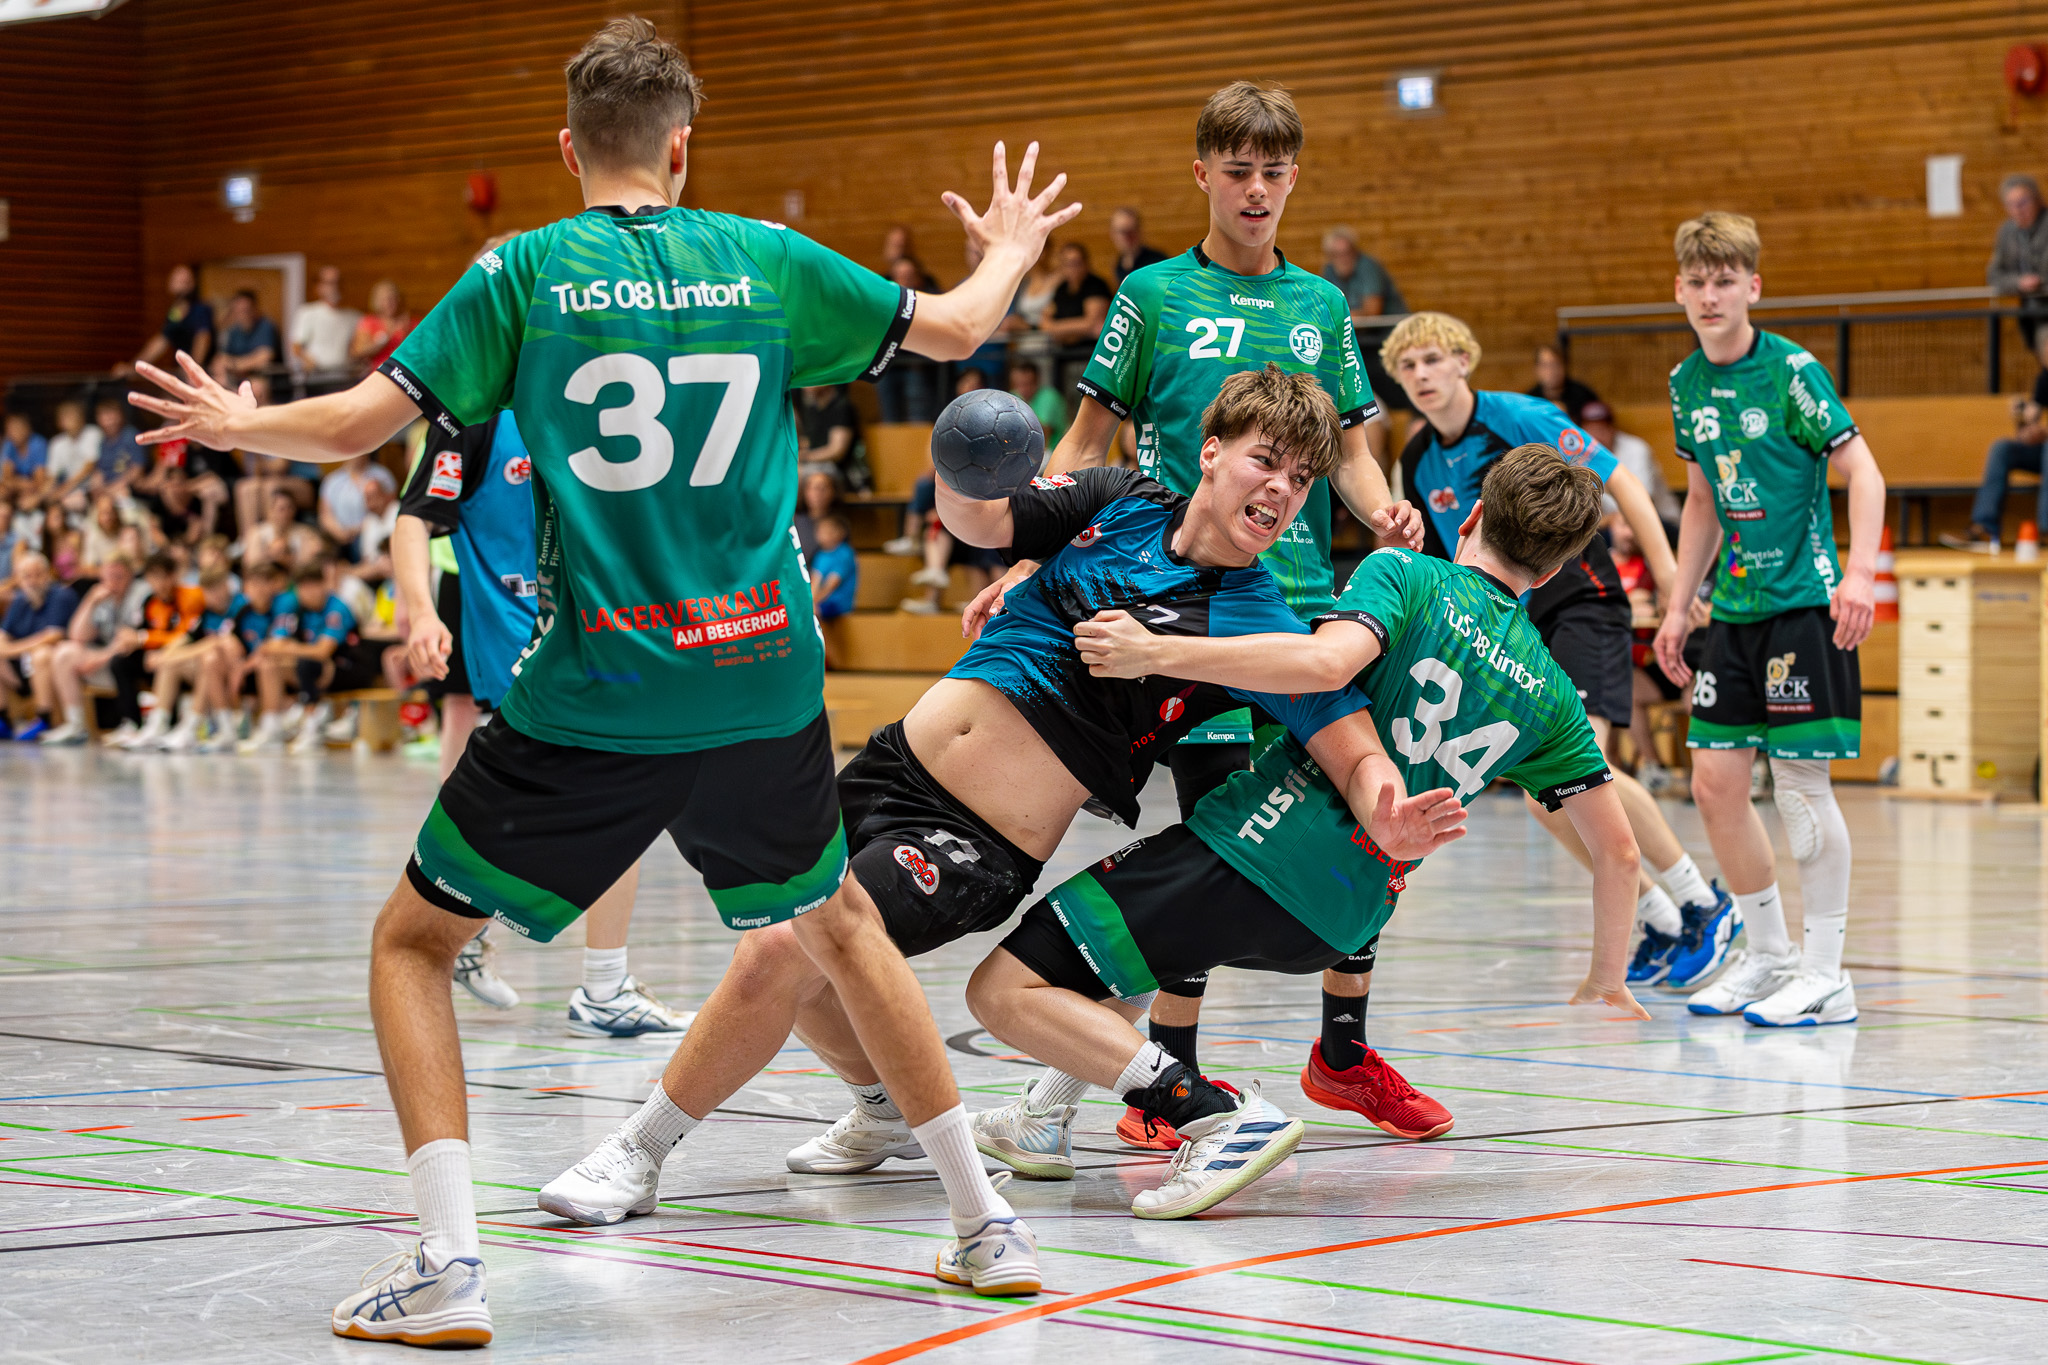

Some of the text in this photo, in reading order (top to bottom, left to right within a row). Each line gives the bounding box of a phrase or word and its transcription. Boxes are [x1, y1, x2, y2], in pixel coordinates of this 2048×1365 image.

[550, 276, 751, 314] TuS 08 Lintorf
[1230, 294, 1274, 309] Kempa
[1185, 318, 1245, 359] 27
[1294, 335, 1321, 350] TUS
[868, 342, 898, 376] Kempa
[390, 366, 423, 401] Kempa
[564, 353, 760, 492] 37
[1691, 406, 1721, 444] 26
[581, 579, 781, 633] LAGERVERKAUF
[1443, 596, 1475, 637] TuS
[676, 608, 787, 646] AM BEEKERHOF
[1357, 612, 1384, 639] Kempa
[1207, 731, 1235, 742] Kempa
[1391, 657, 1520, 801] 34
[1555, 783, 1587, 797] Kempa
[901, 849, 936, 887] HSG
[435, 876, 472, 904] Kempa
[794, 895, 827, 916] Kempa
[493, 909, 530, 936] Kempa
[732, 915, 771, 927] Kempa
[1051, 899, 1070, 928] Kempa
[1078, 942, 1101, 975] Kempa
